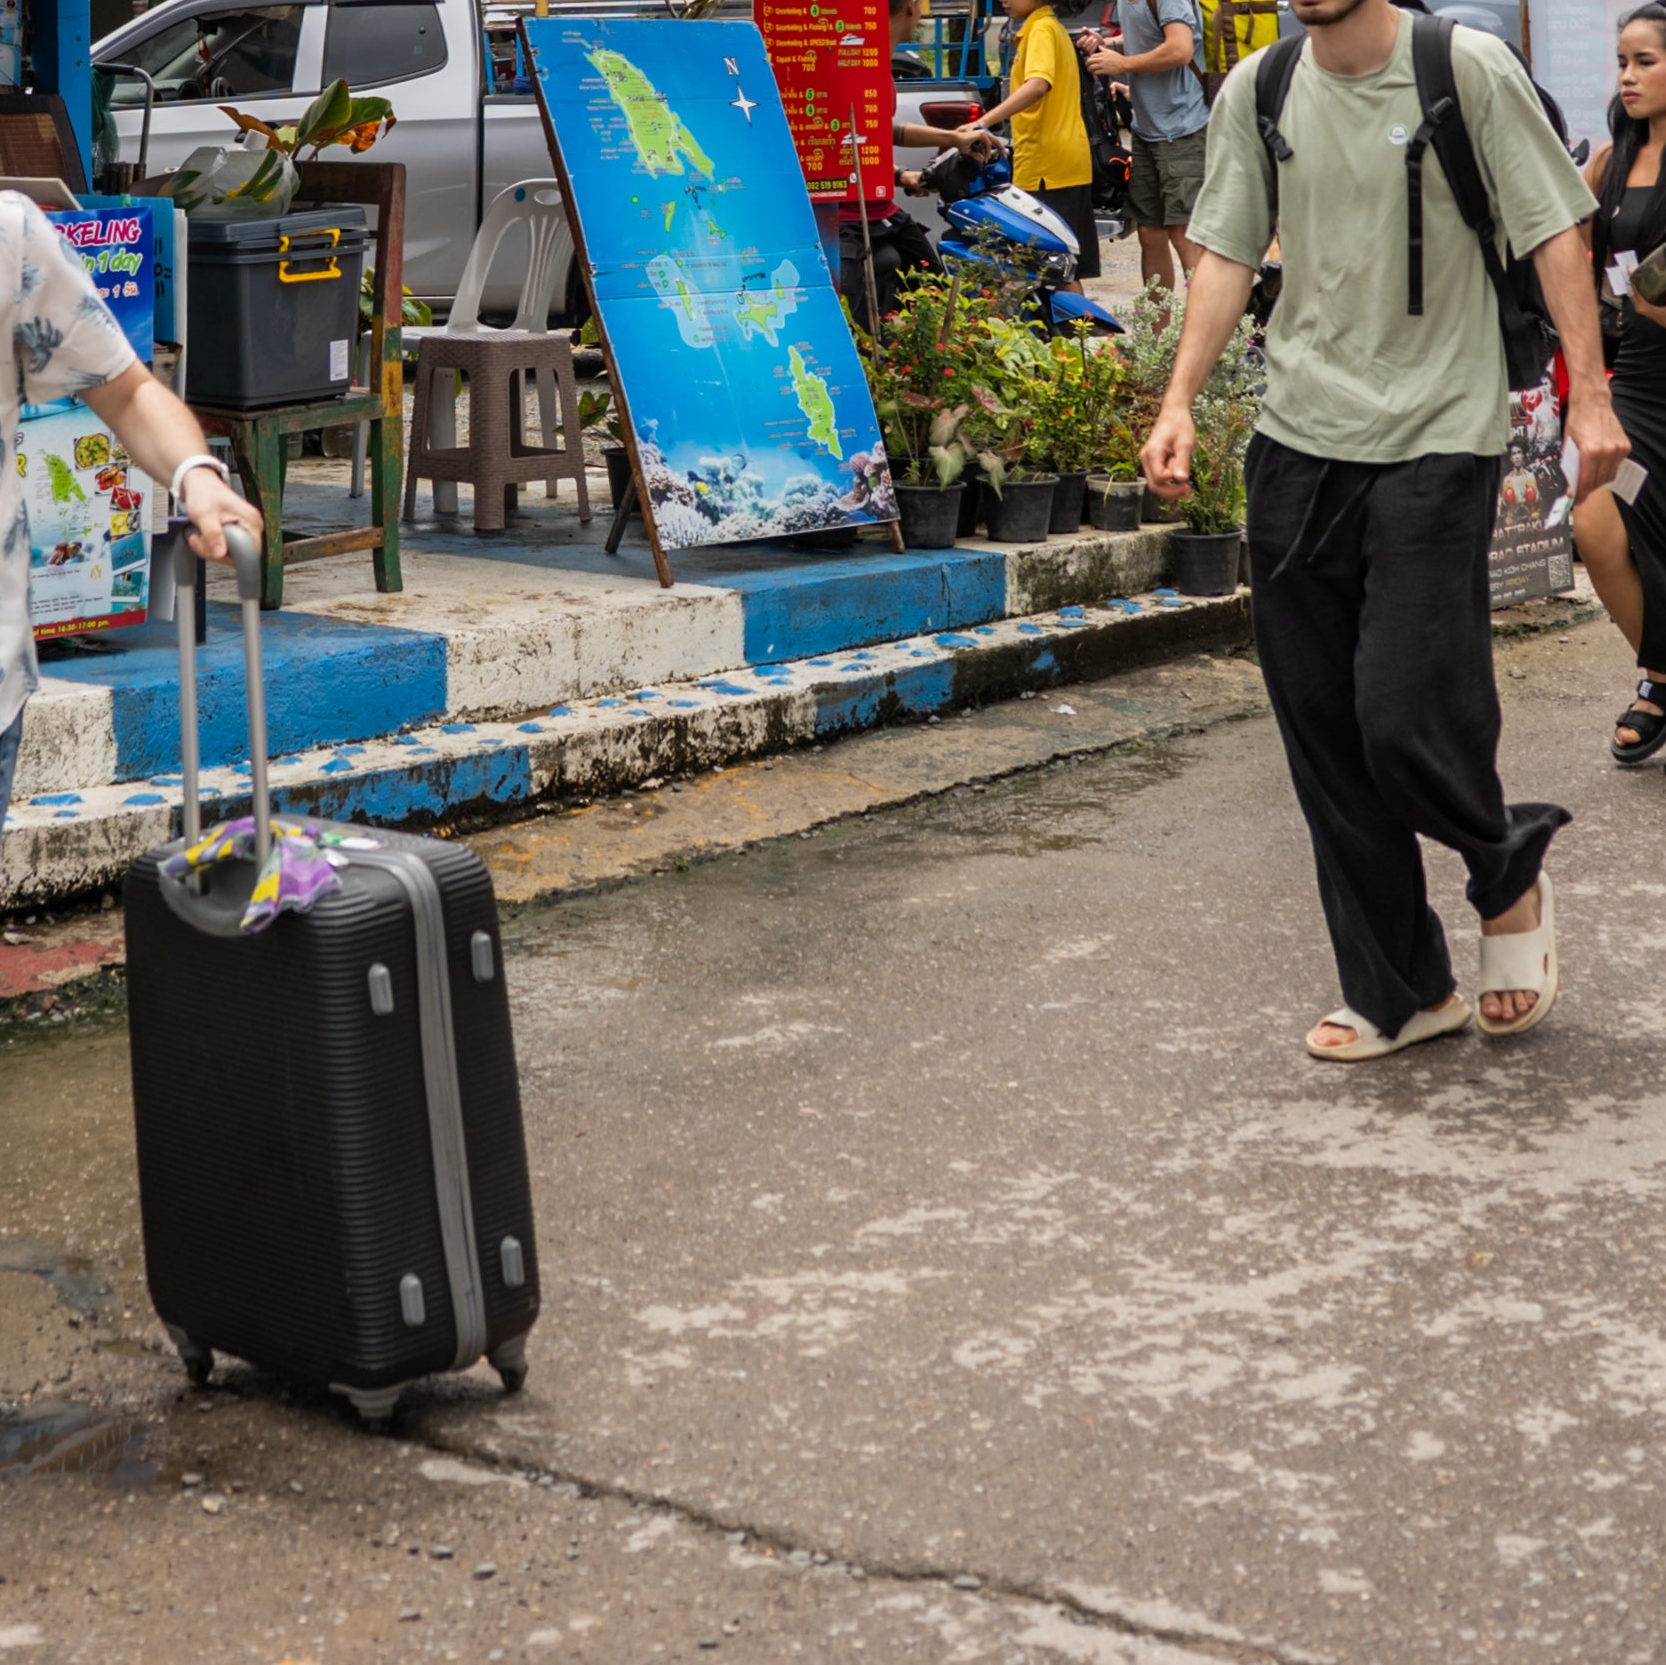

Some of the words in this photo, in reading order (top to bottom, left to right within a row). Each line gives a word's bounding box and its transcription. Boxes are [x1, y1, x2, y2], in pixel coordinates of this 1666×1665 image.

[864, 6, 877, 15] 700
[864, 21, 877, 31] 750
[862, 47, 878, 57] 1200
[723, 56, 740, 77] N
[802, 63, 816, 72] 700
[862, 59, 878, 67] 1000
[863, 89, 878, 98] 850
[864, 104, 878, 113] 700
[865, 119, 878, 128] 750
[860, 145, 879, 154] 1200
[861, 156, 879, 165] 1000
[806, 162, 823, 171] 700
[98, 250, 110, 274] 1
[110, 248, 144, 276] day
[112, 285, 121, 298] 1
[1516, 536, 1565, 556] STADIUM
[1504, 564, 1521, 576] KOH
[1521, 558, 1547, 573] CHANG
[41, 627, 56, 636] time
[58, 620, 97, 633] 16:30-17:00
[97, 619, 110, 628] pm.
